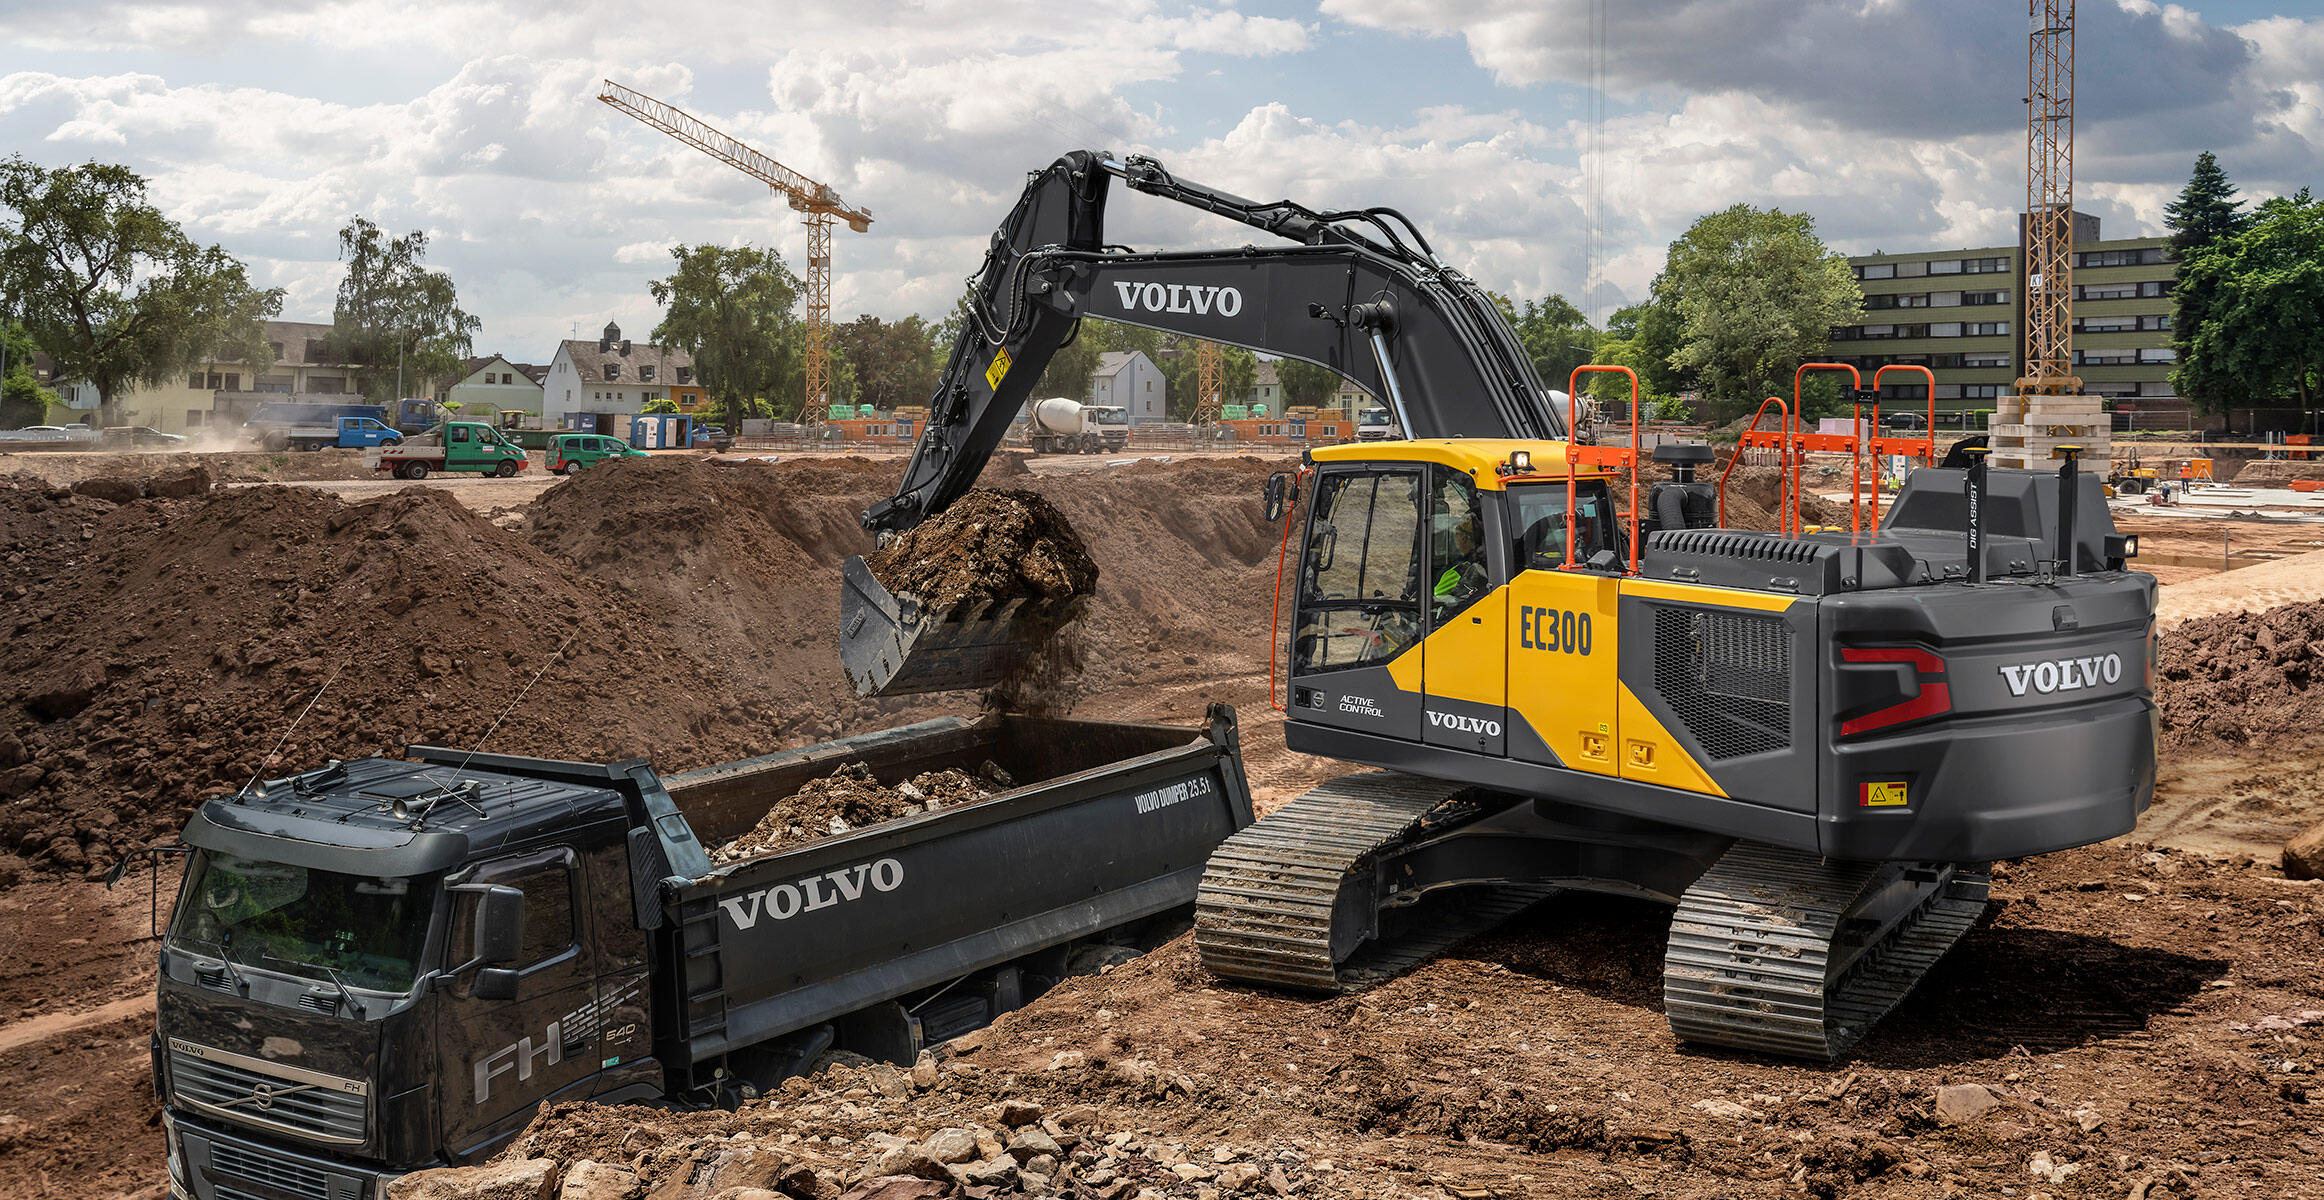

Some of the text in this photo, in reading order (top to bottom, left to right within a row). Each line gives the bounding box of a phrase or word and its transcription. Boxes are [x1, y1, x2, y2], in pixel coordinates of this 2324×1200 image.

[1113, 281, 1243, 318] VOLVO
[1970, 481, 1978, 527] ASSIST
[1521, 605, 1592, 656] EC300
[2000, 652, 2122, 696] VOLVO
[1339, 703, 1385, 718] CONTROL
[1340, 694, 1375, 707] ACTIVE
[1426, 710, 1501, 737] VOLVO
[1134, 790, 1161, 815] VOLVO
[1158, 782, 1189, 808] DUMPER
[718, 858, 904, 931] VOLVO
[172, 1041, 204, 1056] VOLVO
[605, 1023, 637, 1041] 540
[474, 1020, 561, 1105] FH
[344, 1083, 361, 1092] FH
